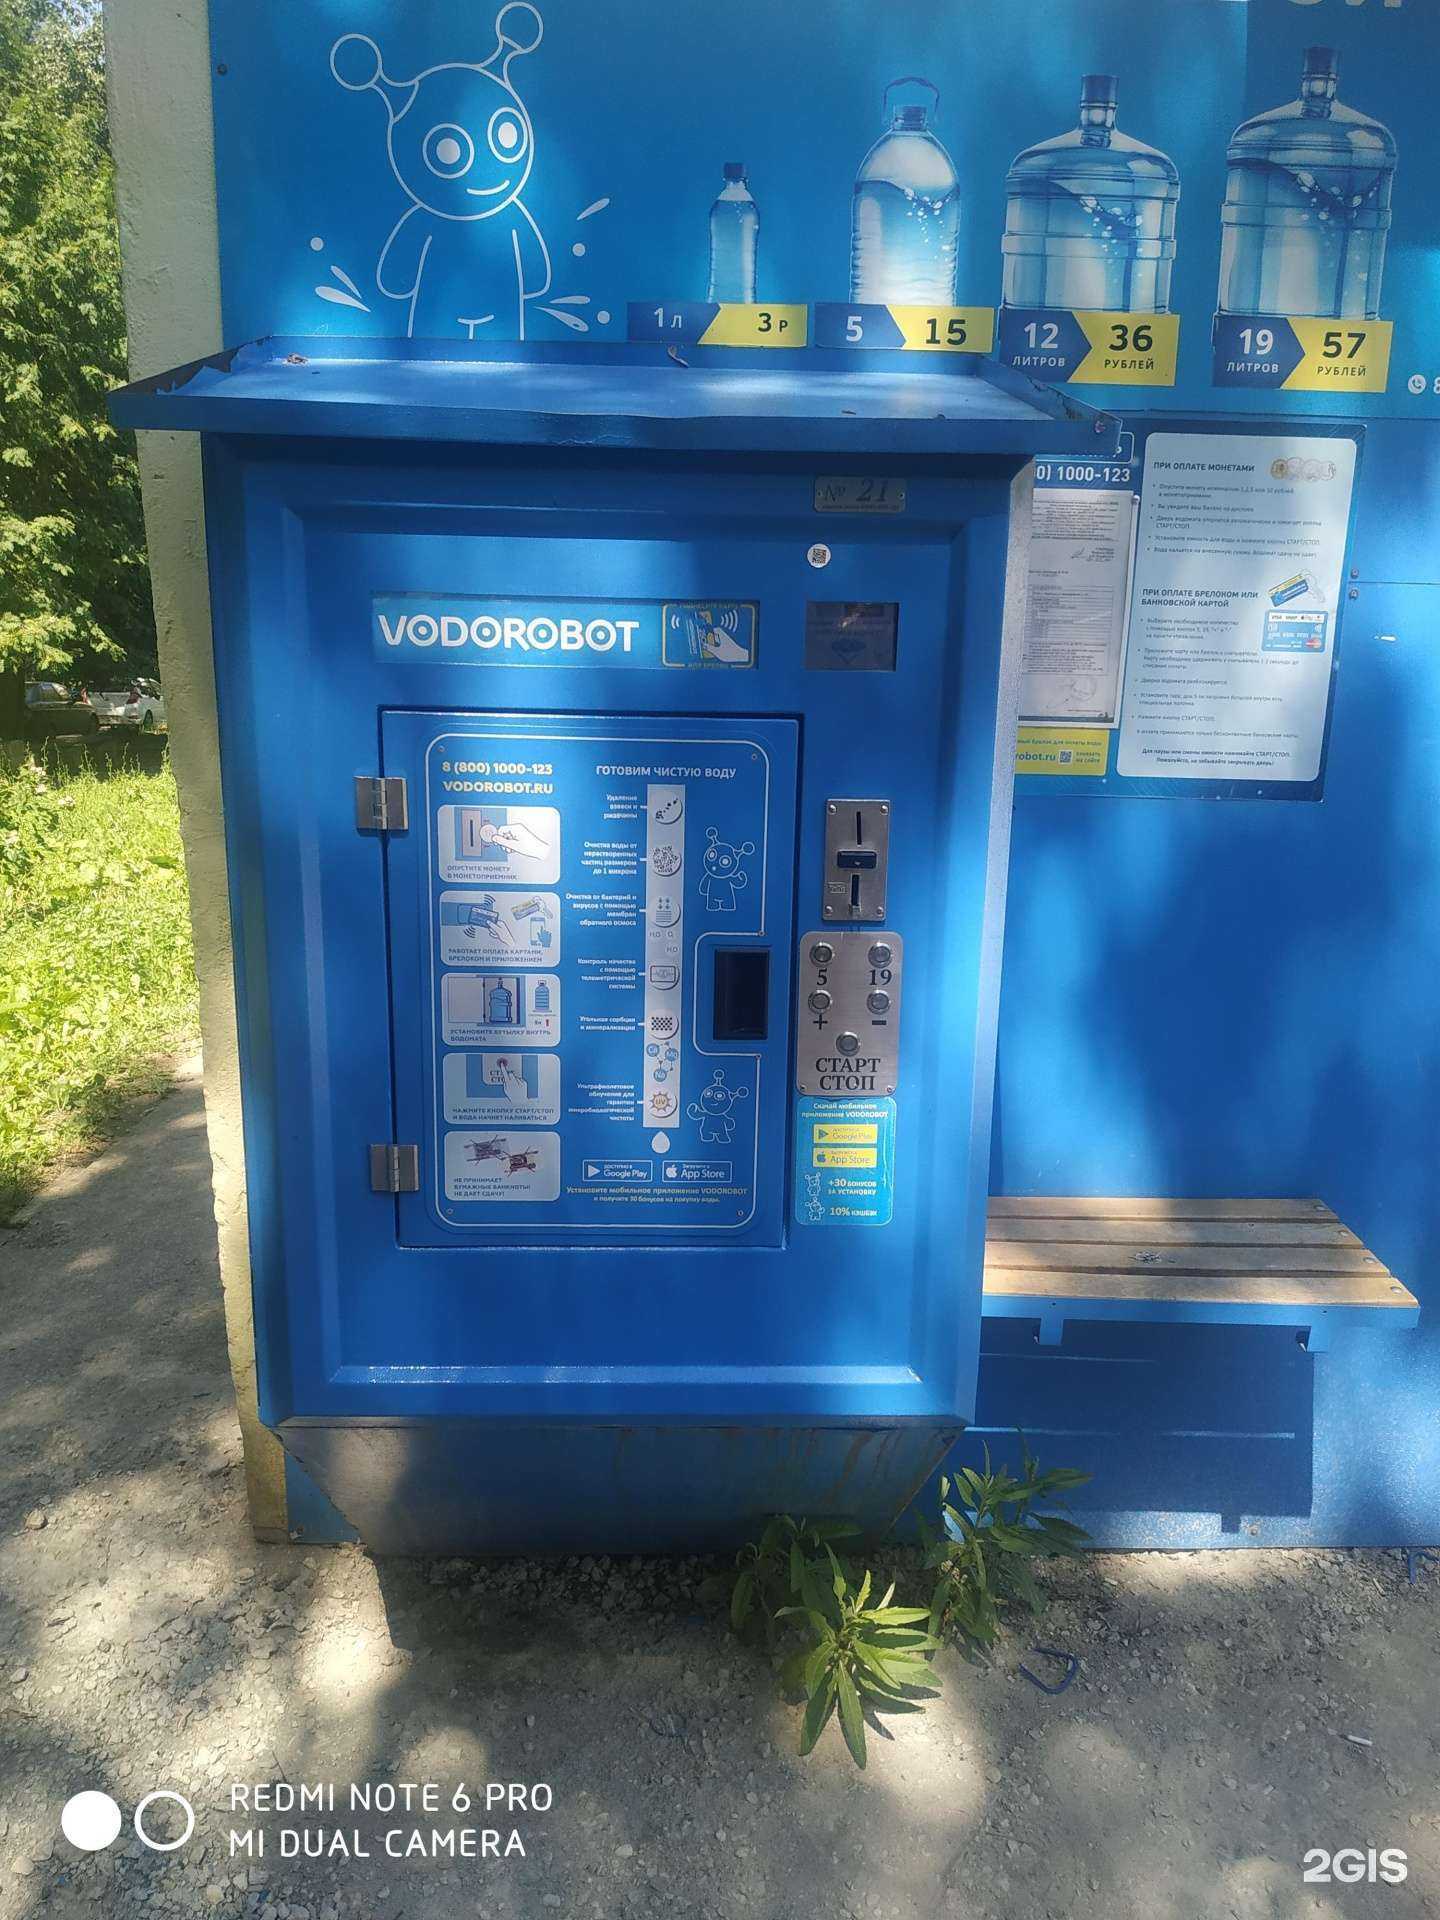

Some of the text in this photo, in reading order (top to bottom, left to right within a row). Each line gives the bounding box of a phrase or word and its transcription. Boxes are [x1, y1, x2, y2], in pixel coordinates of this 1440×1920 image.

[654, 307, 664, 328] 1
[758, 313, 772, 332] 3
[846, 316, 864, 342] 5
[926, 318, 967, 346] 15
[1024, 323, 1059, 349] 12
[1109, 325, 1153, 352] 36
[1239, 329, 1274, 355] 19
[1322, 332, 1366, 359] 57
[1012, 356, 1066, 368] ЛИТРОВ
[1104, 357, 1155, 371] РУБЛЕЙ
[1227, 361, 1279, 373] ЛИТРОВ
[1316, 364, 1367, 377] РУБЛЕЙ
[1153, 461, 1255, 472] ПРИ ОПЛАТЕ МОНЕТАМИ
[1057, 466, 1131, 482] 1000-123
[855, 479, 888, 503] 21
[1142, 588, 1160, 596] ПРИ
[1161, 589, 1193, 597] ОПЛАТЕ
[1240, 591, 1258, 599] ИЛИ
[1141, 598, 1229, 608] БАНКОВСКОЙ КАРТОЙ
[378, 614, 640, 652] VODOROBOT
[442, 762, 553, 775] 8 (800) 1000-123
[596, 765, 737, 779] ГОТОВИМ ЧИСТУЮ ВОДУ
[443, 781, 553, 794] VODOROBOT.RU
[584, 841, 611, 849] Очистка
[603, 860, 637, 868] размером
[601, 893, 631, 901] бактерий
[580, 919, 613, 927] обратного
[816, 968, 892, 986] 5 19
[815, 1058, 881, 1073] СТАРТ
[819, 1075, 876, 1090] СТОП
[830, 1156, 848, 1165] App
[603, 1169, 648, 1179] Google Play
[680, 1170, 725, 1180] App Store
[828, 1178, 847, 1187] +30
[566, 1186, 608, 1194] Установите
[830, 1207, 850, 1216] 10%
